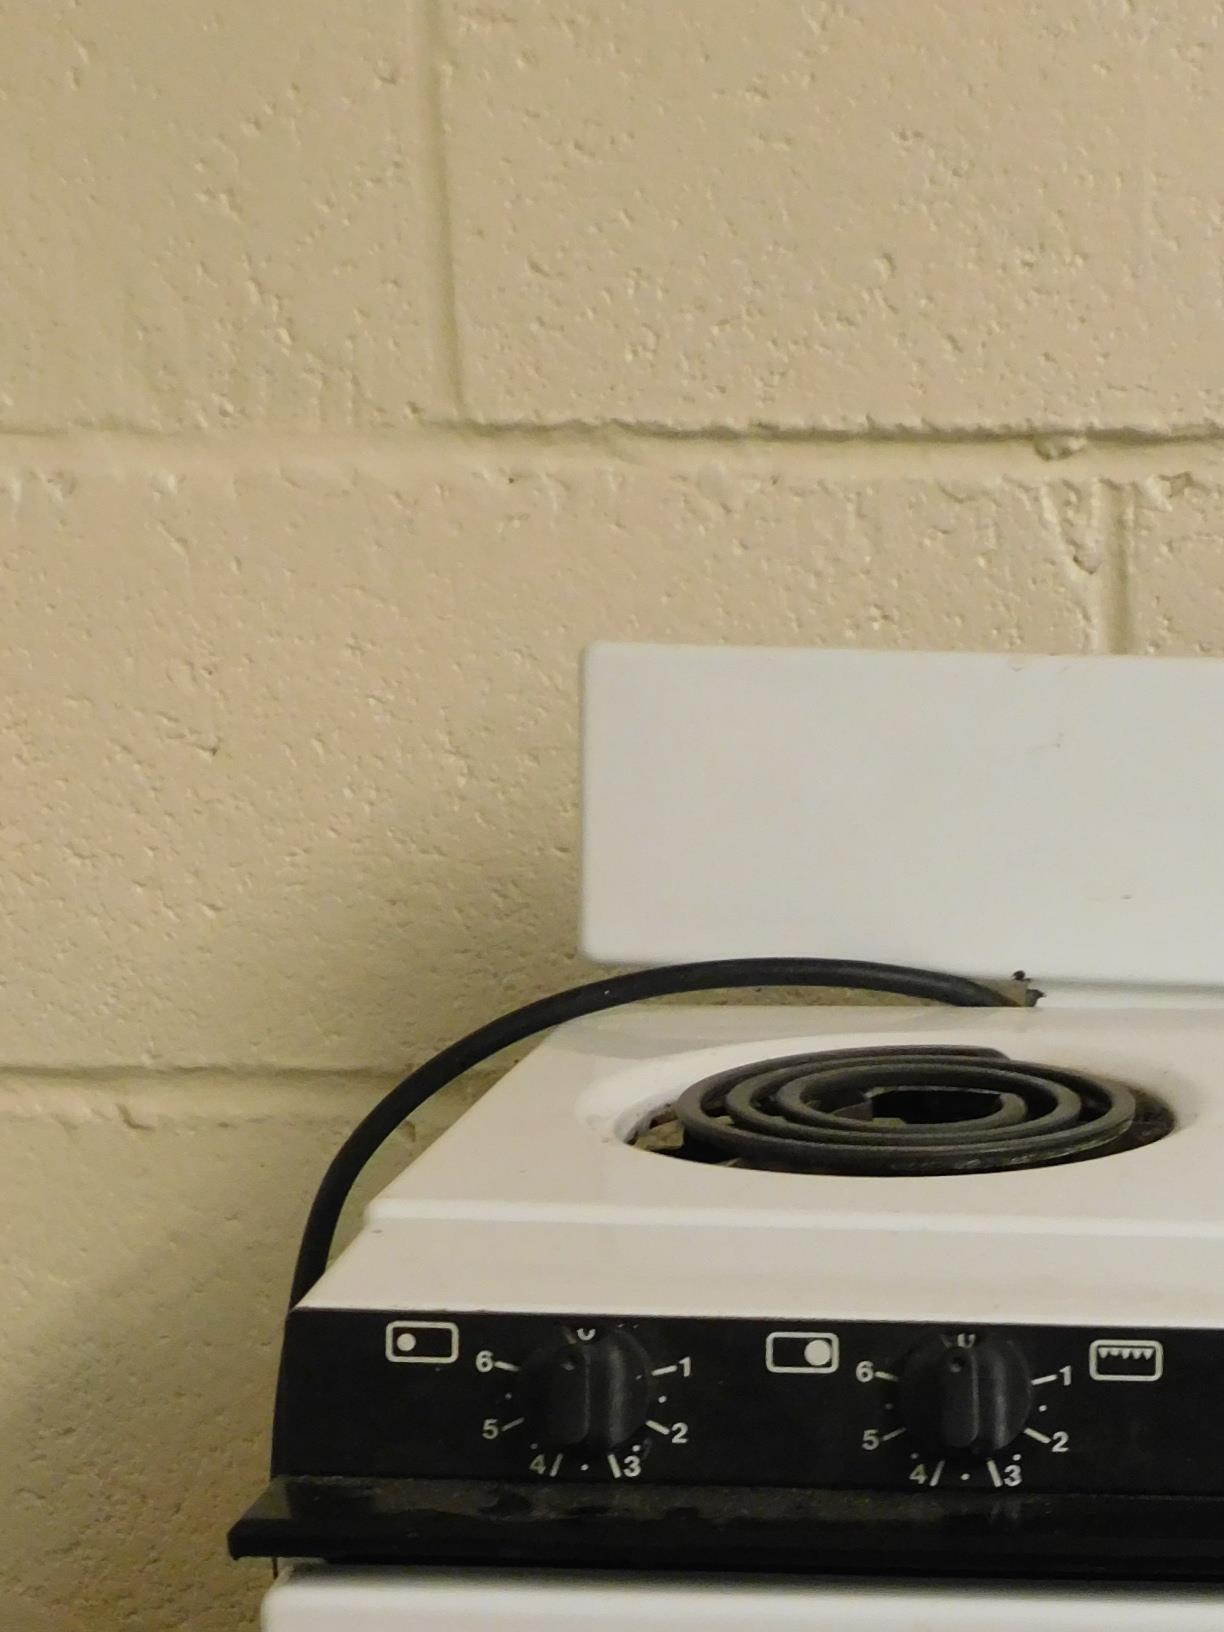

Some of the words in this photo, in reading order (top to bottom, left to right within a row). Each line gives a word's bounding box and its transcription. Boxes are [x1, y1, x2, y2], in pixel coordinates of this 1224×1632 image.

[475, 1351, 494, 1373] 6
[677, 1356, 692, 1377] 1
[855, 1360, 875, 1383] 6
[1058, 1365, 1072, 1386] 1
[482, 1418, 499, 1440] 5
[671, 1422, 689, 1444] 2
[862, 1429, 880, 1450] 5
[1052, 1432, 1070, 1453] 2
[529, 1454, 545, 1475] 4
[623, 1455, 642, 1477] 3
[909, 1464, 927, 1485] 4
[1004, 1465, 1023, 1487] 3
